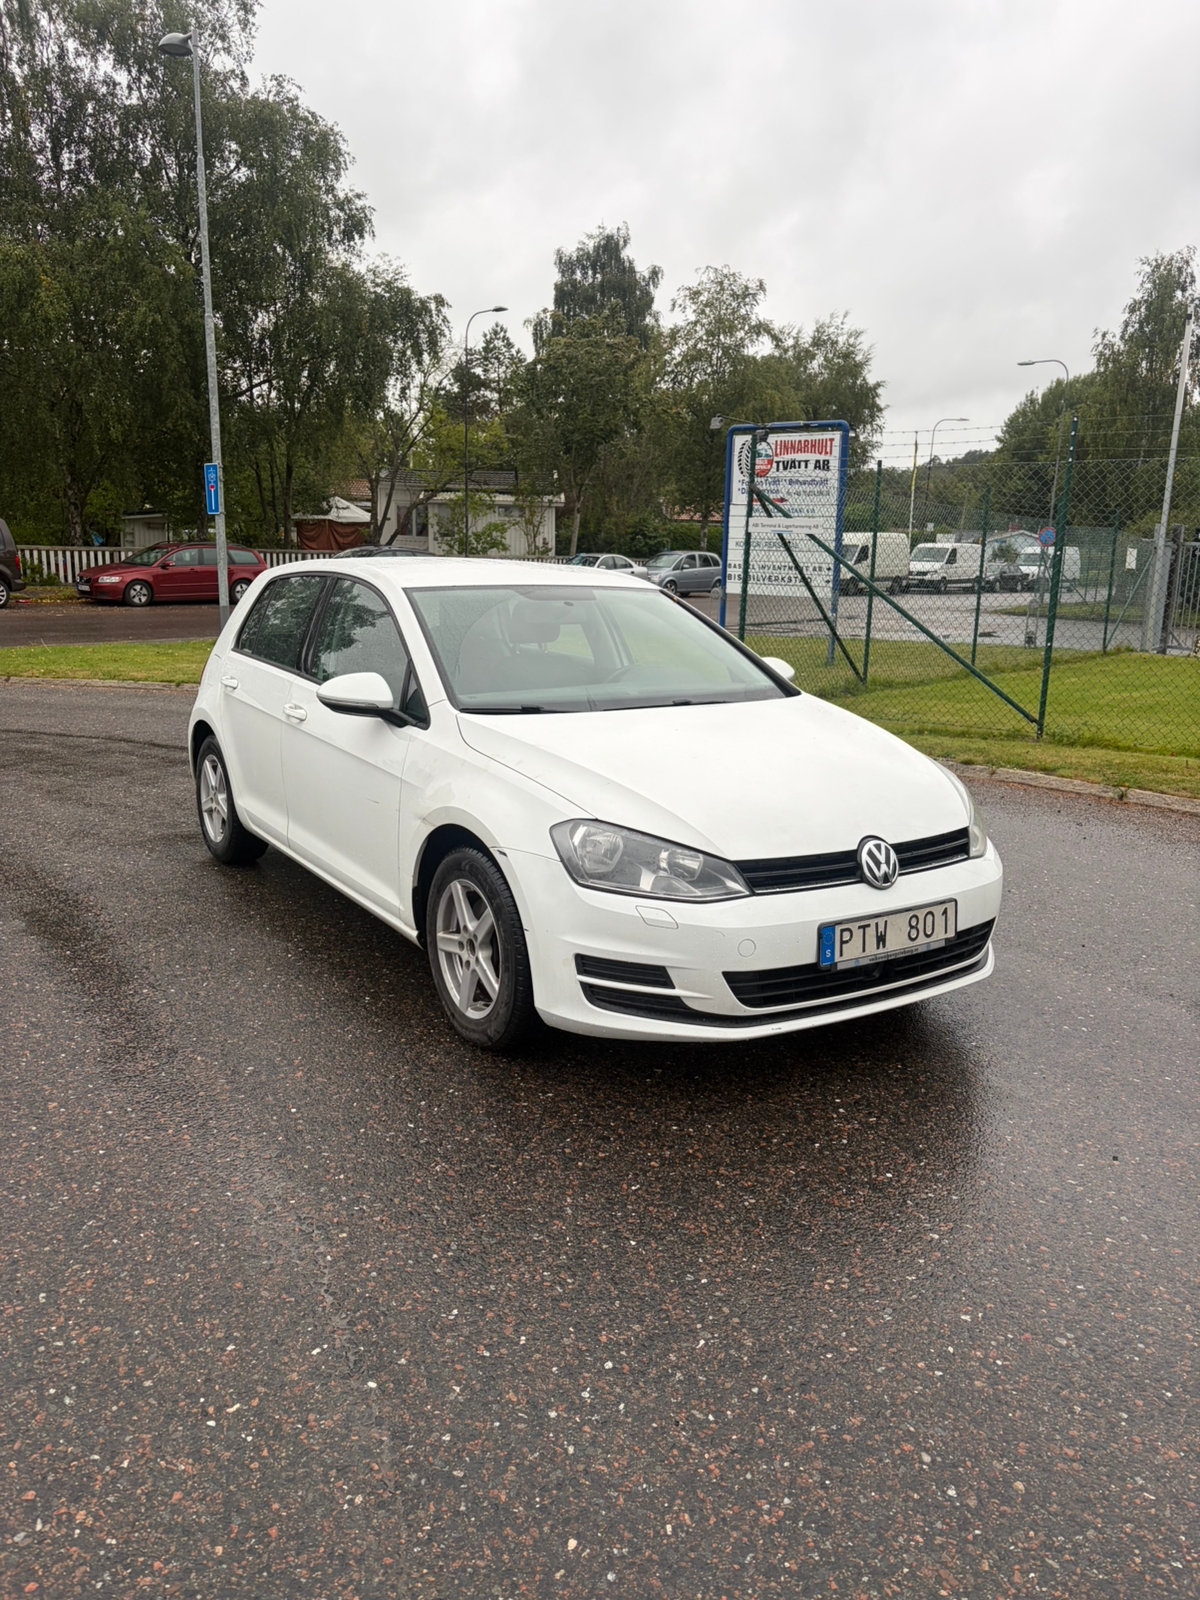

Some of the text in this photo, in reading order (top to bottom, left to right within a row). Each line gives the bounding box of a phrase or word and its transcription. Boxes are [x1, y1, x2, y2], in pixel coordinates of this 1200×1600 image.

[774, 438, 835, 457] LINNARHULT
[775, 458, 810, 472] TVÄTT
[727, 573, 742, 581] BIS
[839, 907, 948, 957] PTW 801
[825, 949, 831, 958] S
